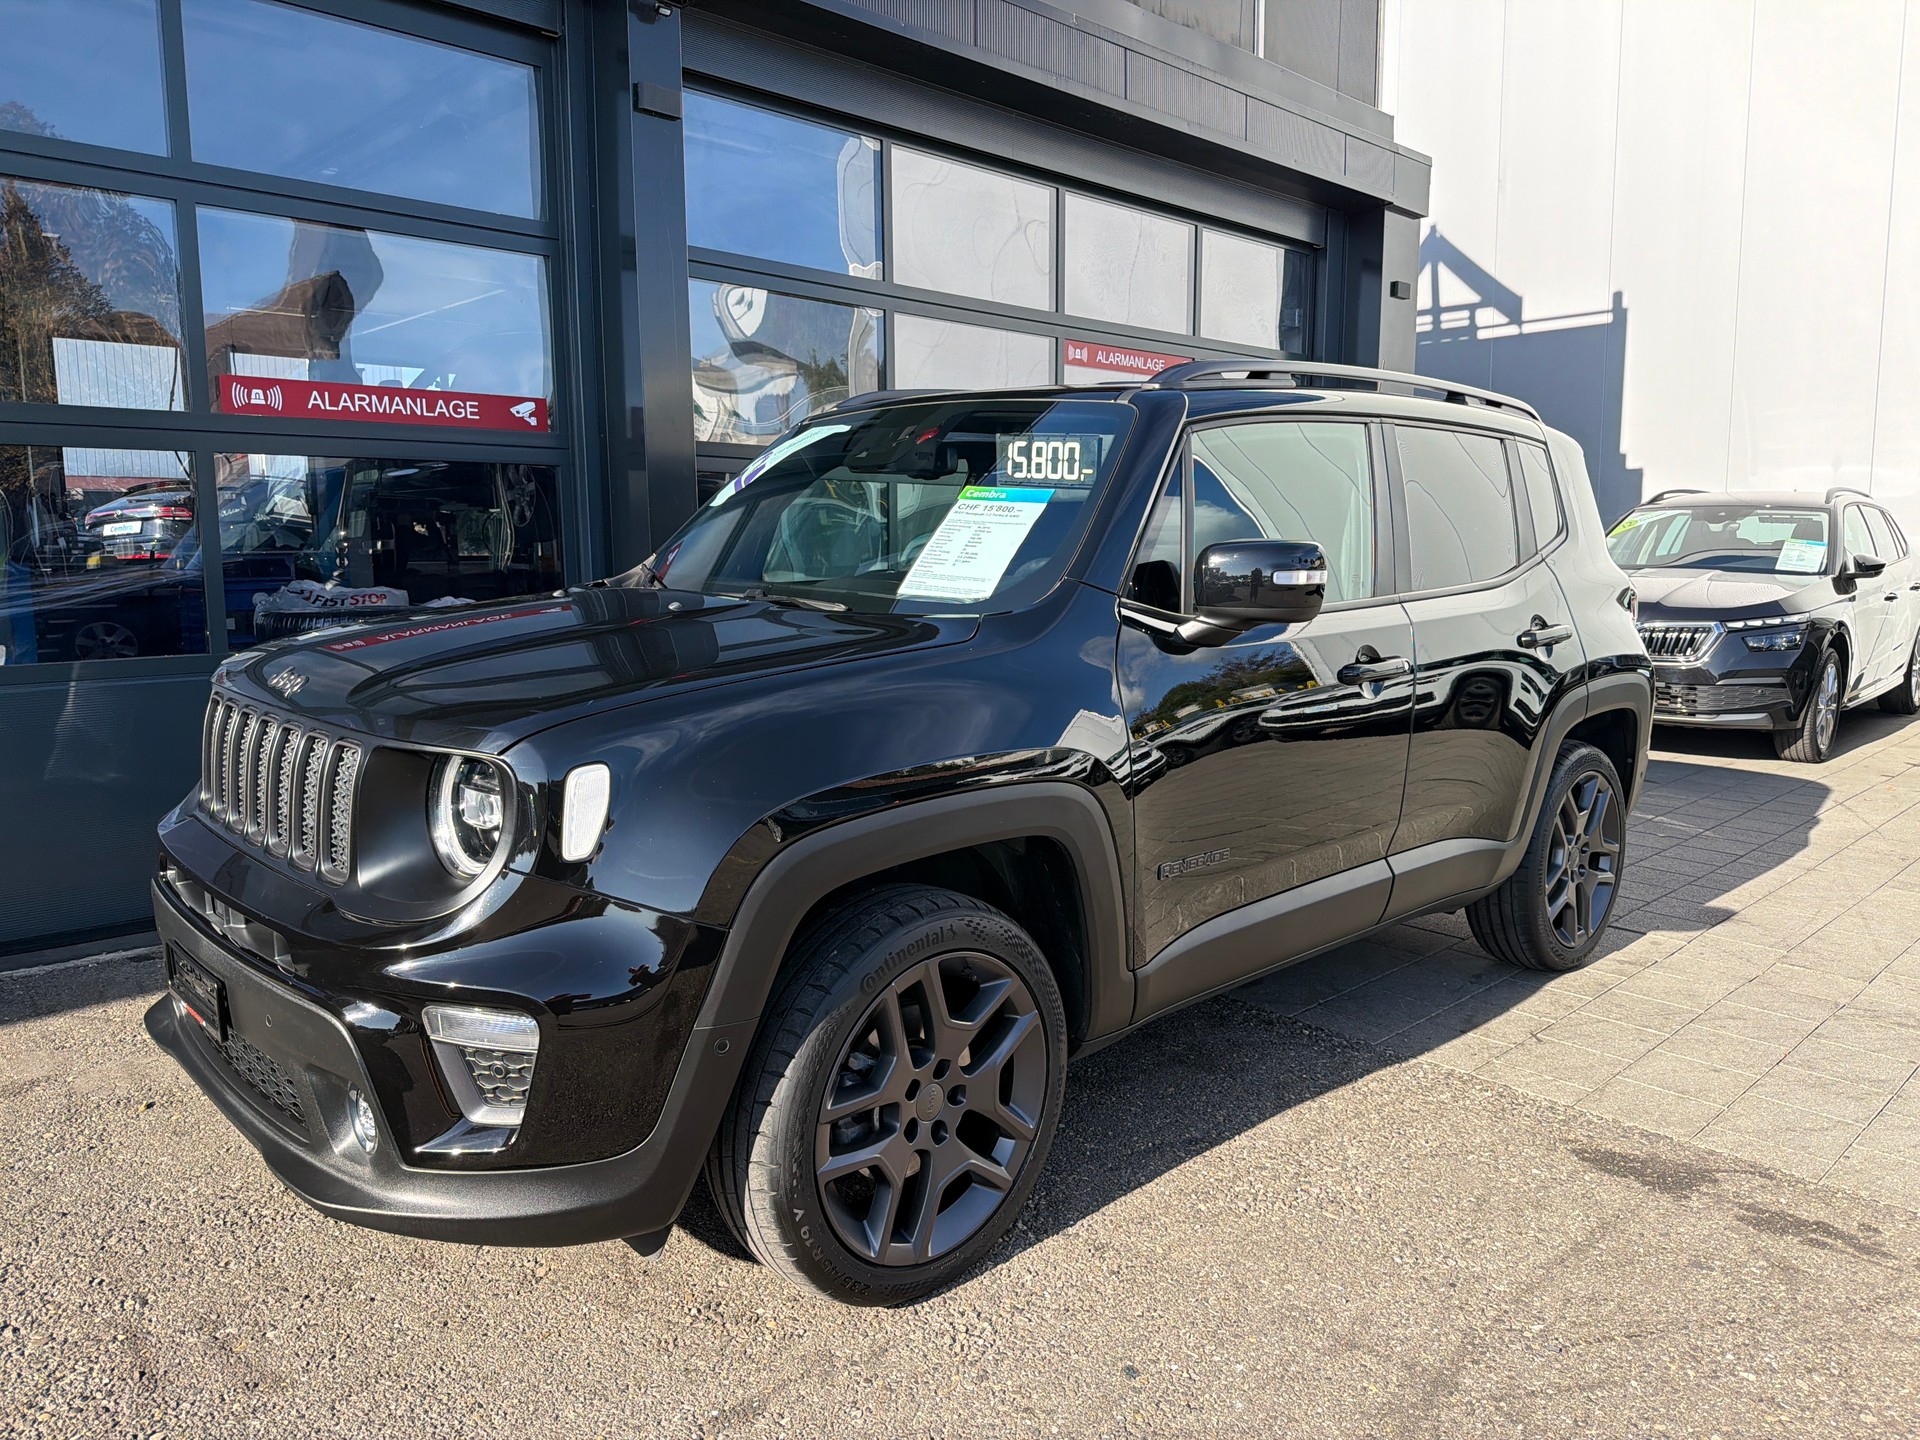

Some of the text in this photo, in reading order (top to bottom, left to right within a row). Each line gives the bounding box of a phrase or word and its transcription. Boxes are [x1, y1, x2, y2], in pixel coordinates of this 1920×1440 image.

[1096, 351, 1165, 371] ALARMANLAGE
[307, 391, 480, 419] ALARMANLAGE
[965, 489, 1007, 499] Cembra
[957, 503, 981, 511] CHF
[110, 525, 133, 533] Cembra
[349, 593, 387, 605] STOP
[268, 666, 307, 699] Jeep
[1159, 848, 1231, 880] RENEGADE
[860, 926, 945, 995] Continental
